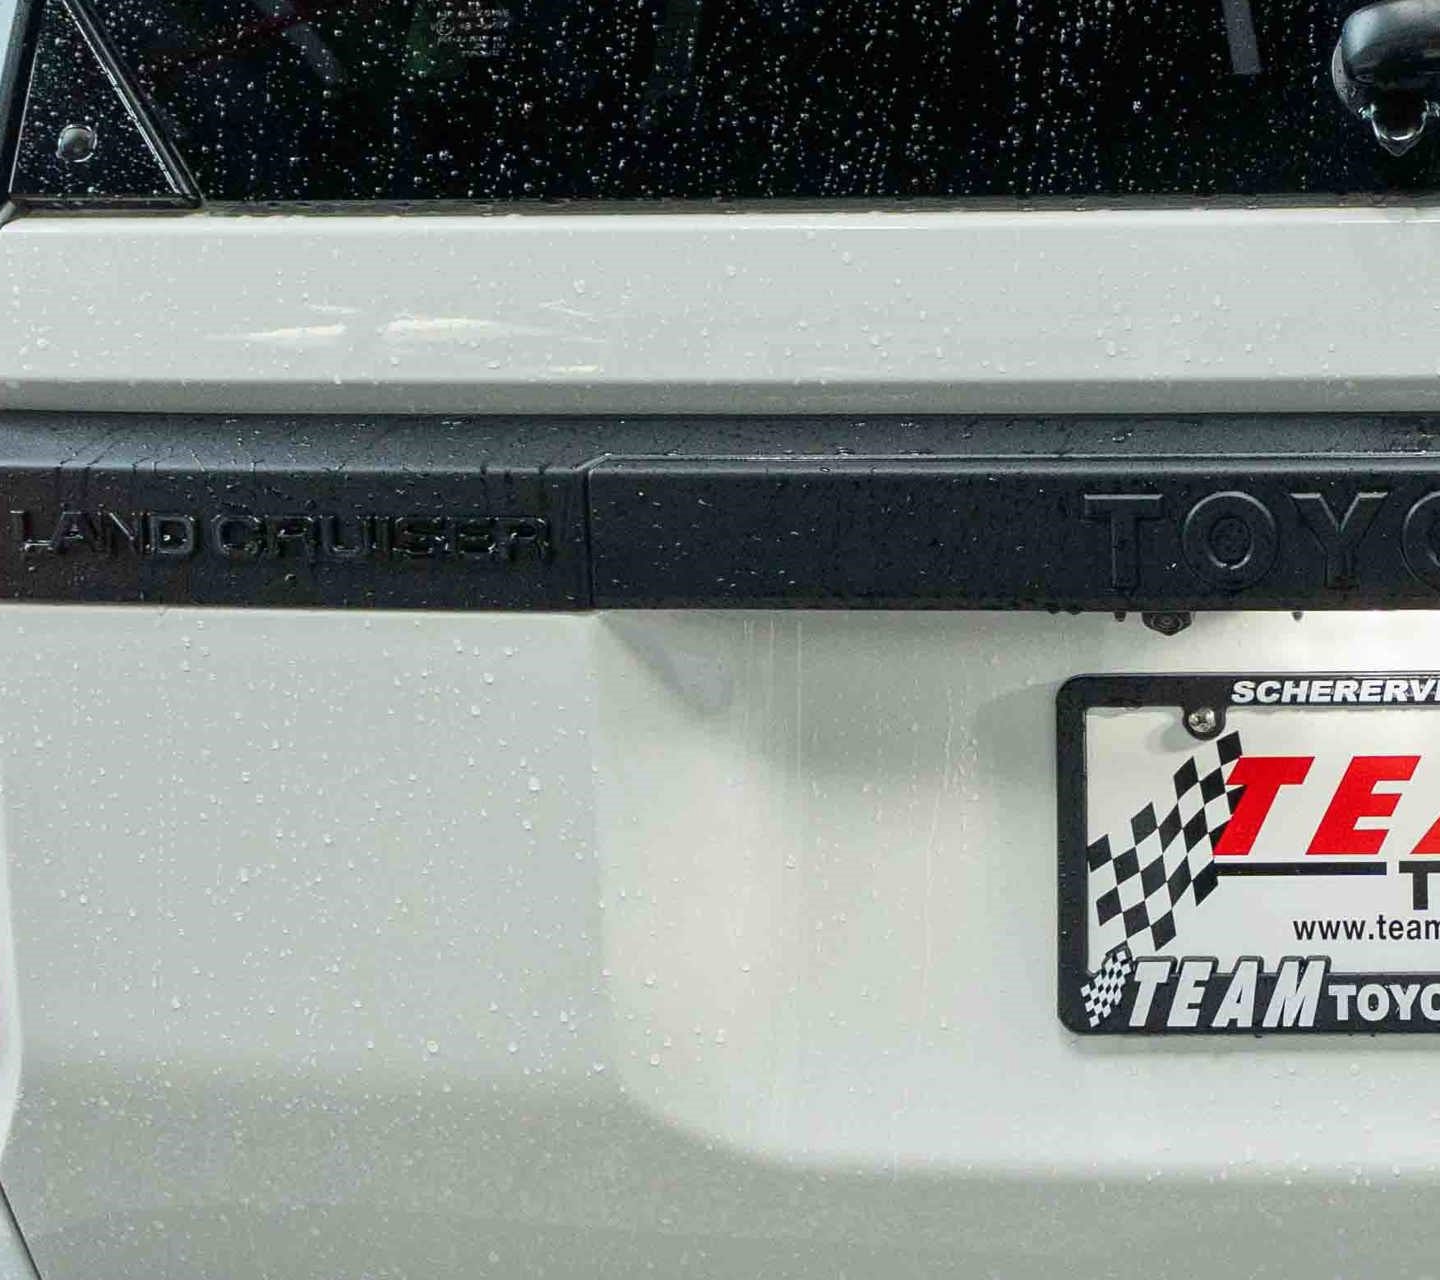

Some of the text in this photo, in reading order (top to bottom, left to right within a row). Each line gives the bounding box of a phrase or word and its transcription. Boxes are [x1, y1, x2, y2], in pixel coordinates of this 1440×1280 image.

[9, 509, 553, 558] LAND CRUISER
[1127, 959, 1329, 1028] TEAM
